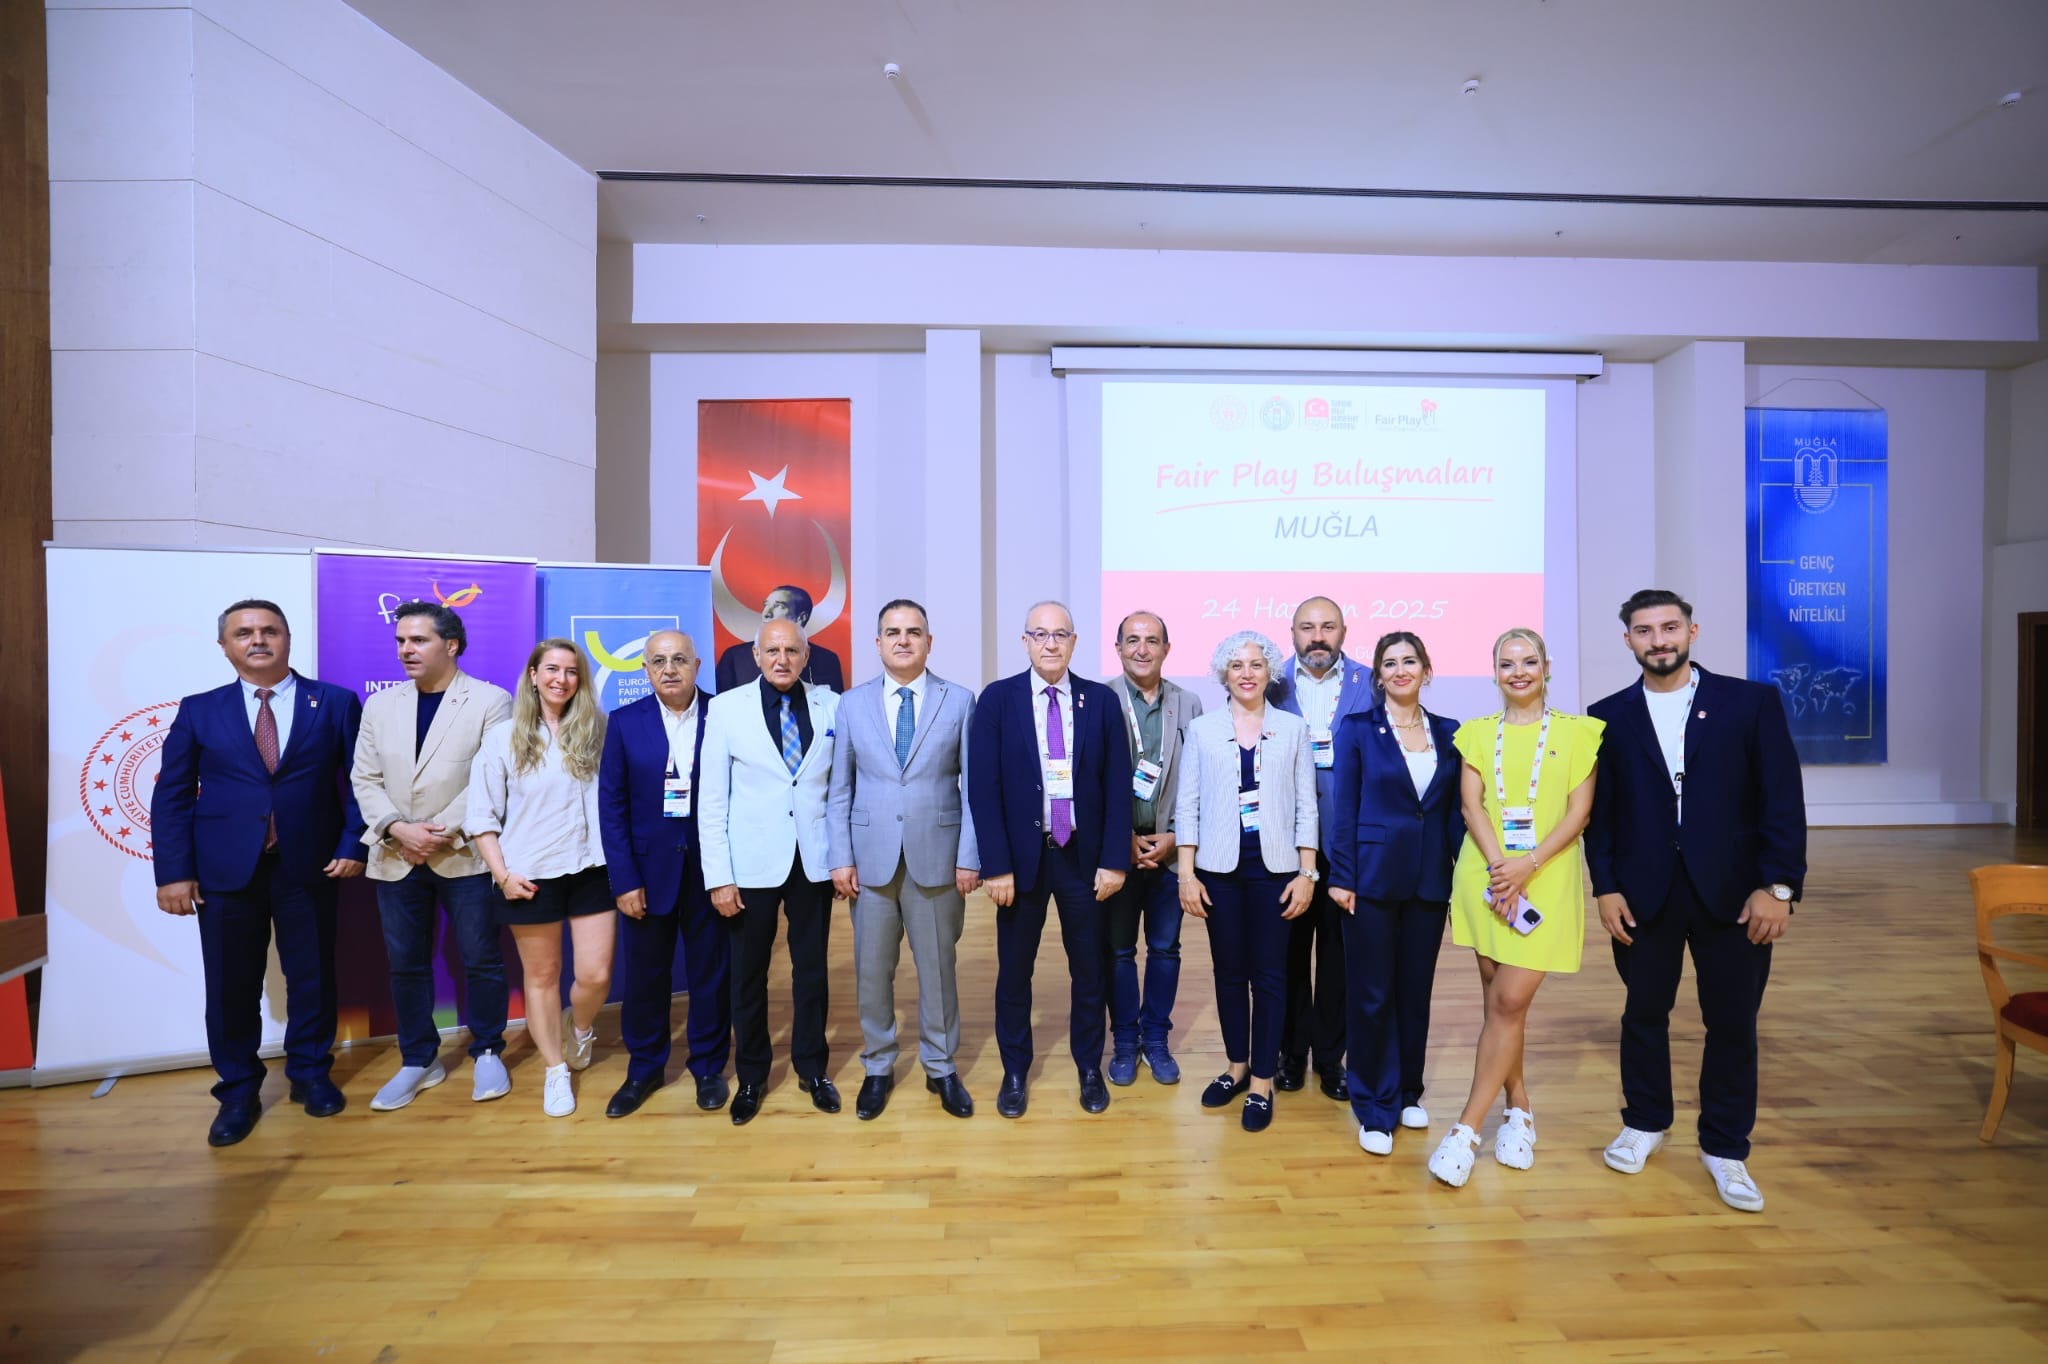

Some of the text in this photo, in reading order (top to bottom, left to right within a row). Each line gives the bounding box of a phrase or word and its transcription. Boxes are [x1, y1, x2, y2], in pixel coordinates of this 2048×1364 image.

[1375, 414, 1396, 425] Fair
[1398, 414, 1422, 428] Play
[1793, 436, 1838, 447] MUĞLA
[1156, 457, 1494, 495] Fair Play Buluşmaları
[1273, 510, 1379, 540] MUĞLA
[1799, 555, 1835, 574] GENÇ
[1788, 578, 1846, 597] ÜRETKEN
[1201, 596, 1449, 619] 24 Hazn 2025
[1789, 604, 1846, 623] NİTELİKLİ
[618, 678, 651, 687] EUROP
[618, 687, 640, 696] FAIR
[119, 733, 165, 827] RKİYE CUMHURİYETİ
